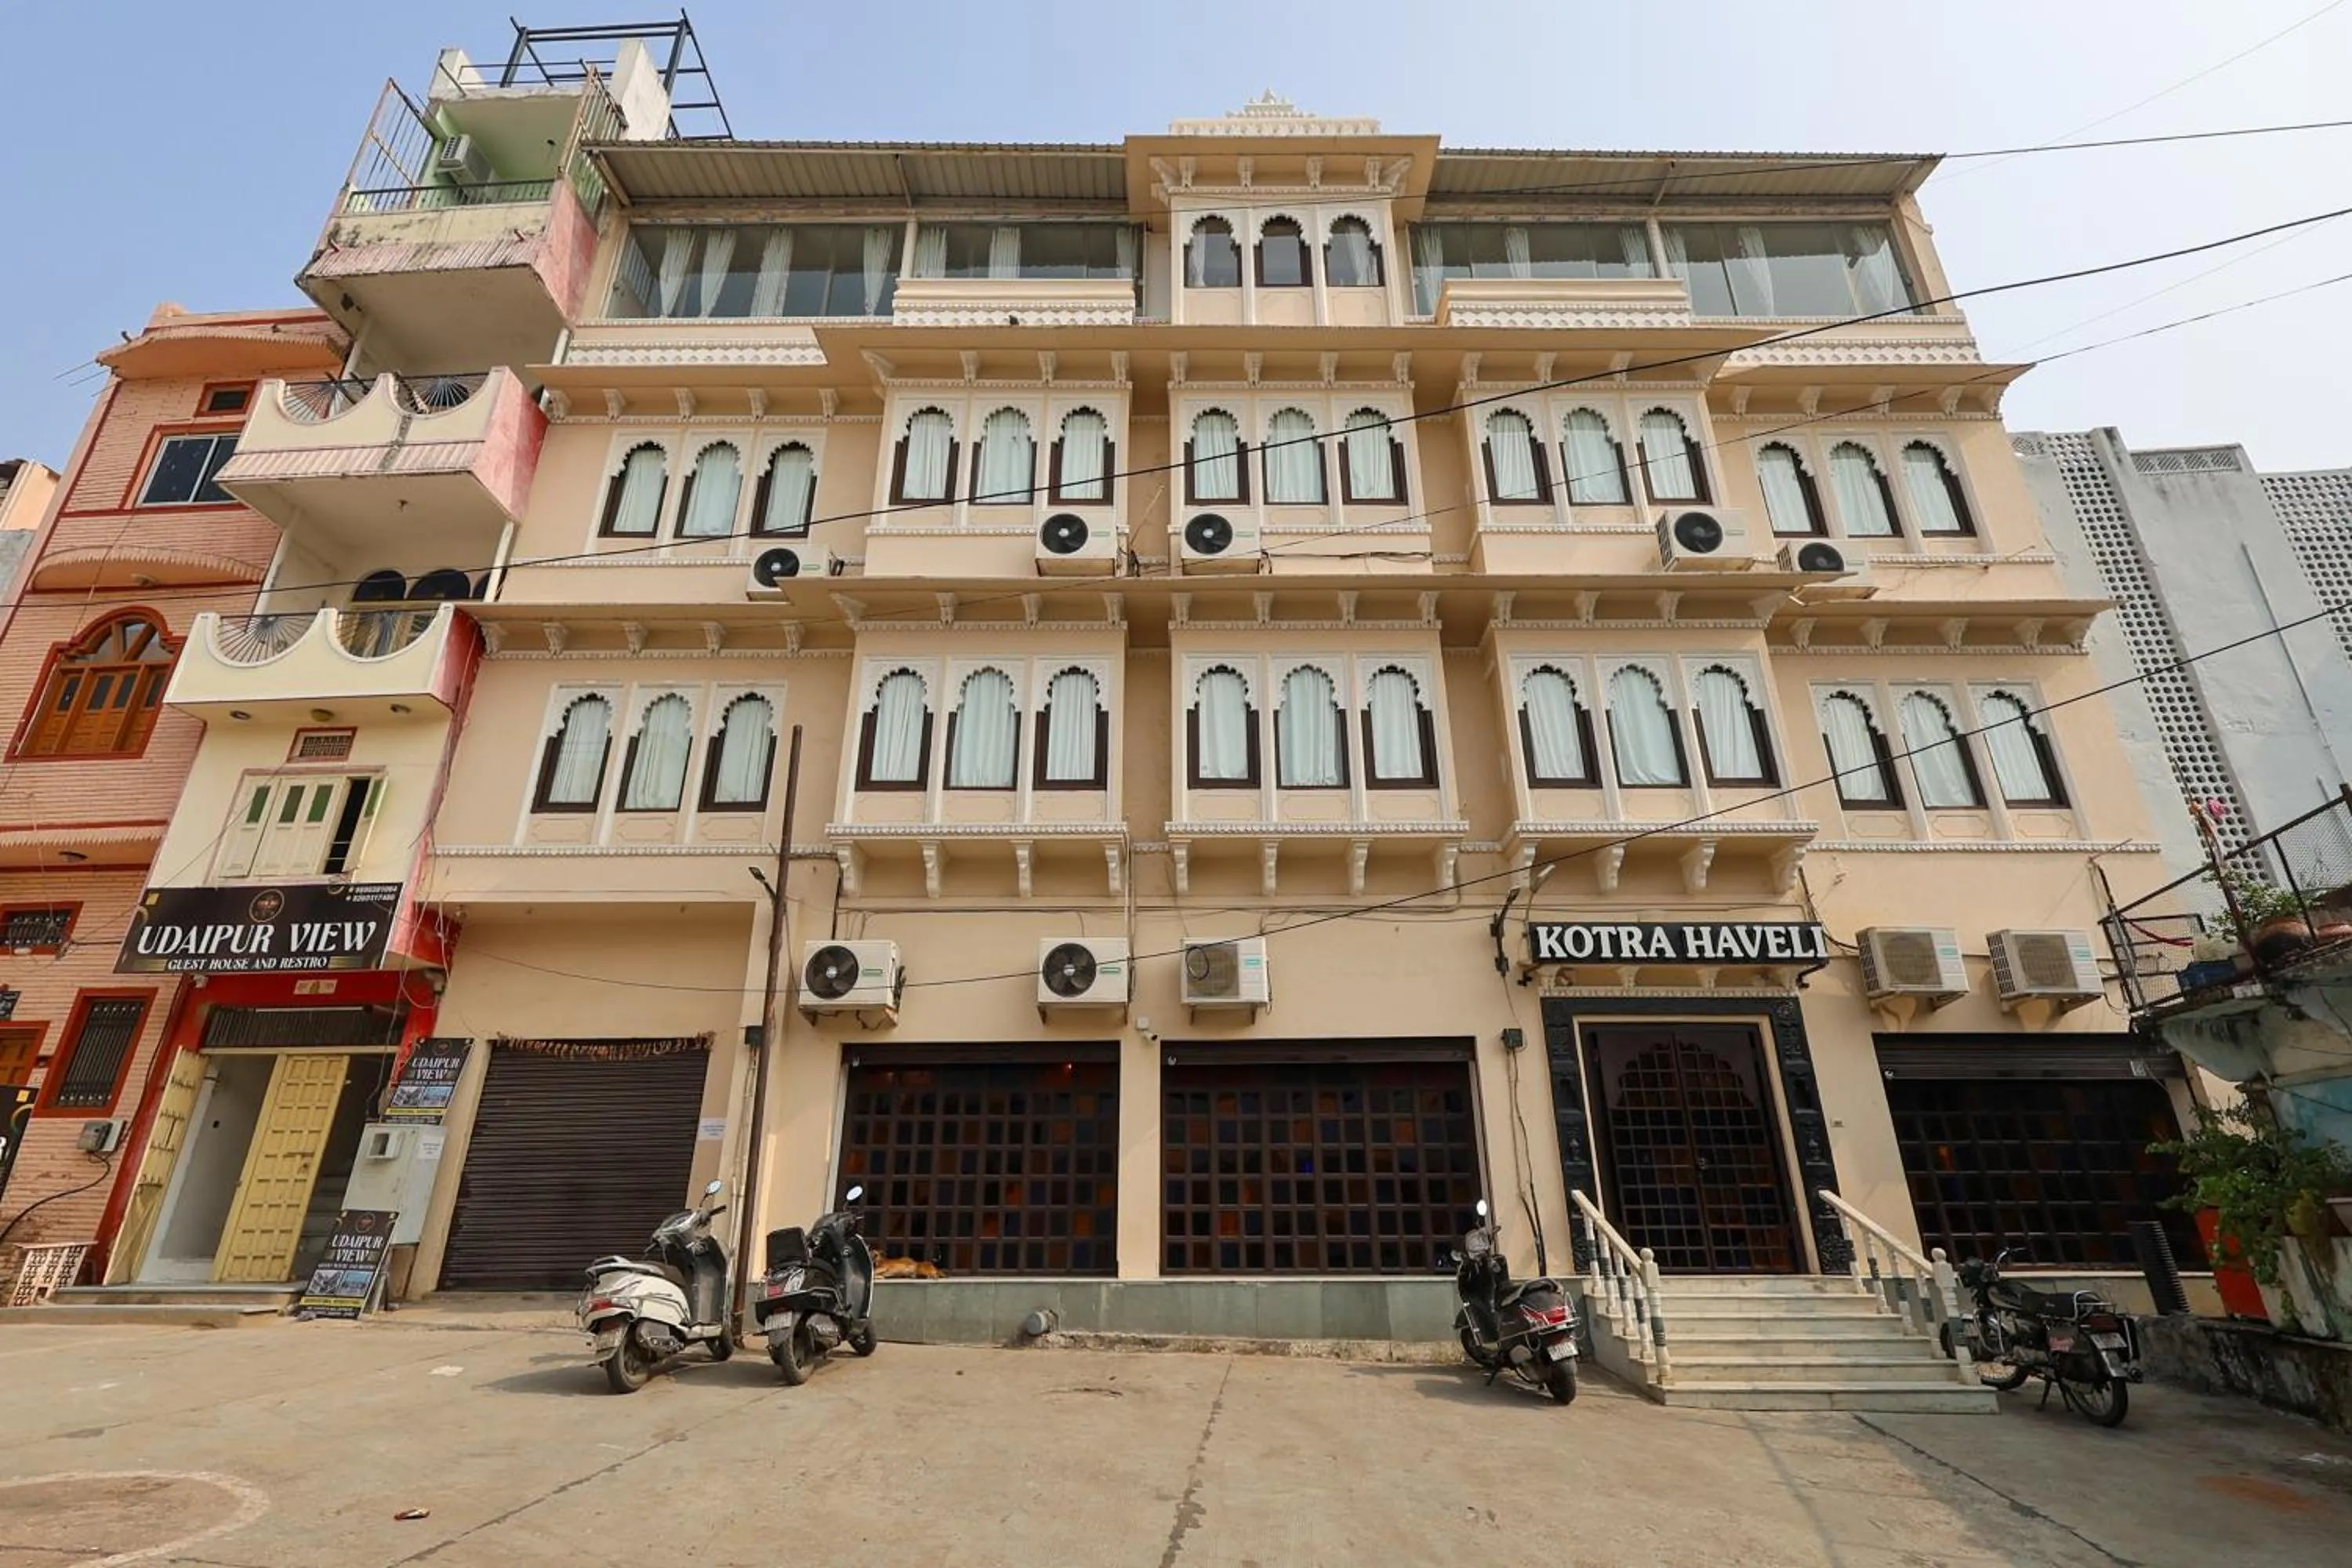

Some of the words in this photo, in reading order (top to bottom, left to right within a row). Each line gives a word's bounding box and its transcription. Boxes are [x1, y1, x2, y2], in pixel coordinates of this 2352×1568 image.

[136, 924, 275, 954] UDAIPUR
[289, 921, 377, 953] VIEW
[1536, 925, 1677, 958] KOTRA
[1682, 925, 1828, 958] HAVELI
[168, 958, 208, 971] GUEST
[209, 958, 249, 970] HOUSE
[251, 957, 278, 969] AND
[279, 956, 328, 969] RESTRO
[331, 1233, 384, 1249] UDAIPUR
[336, 1248, 370, 1262] VIEW
